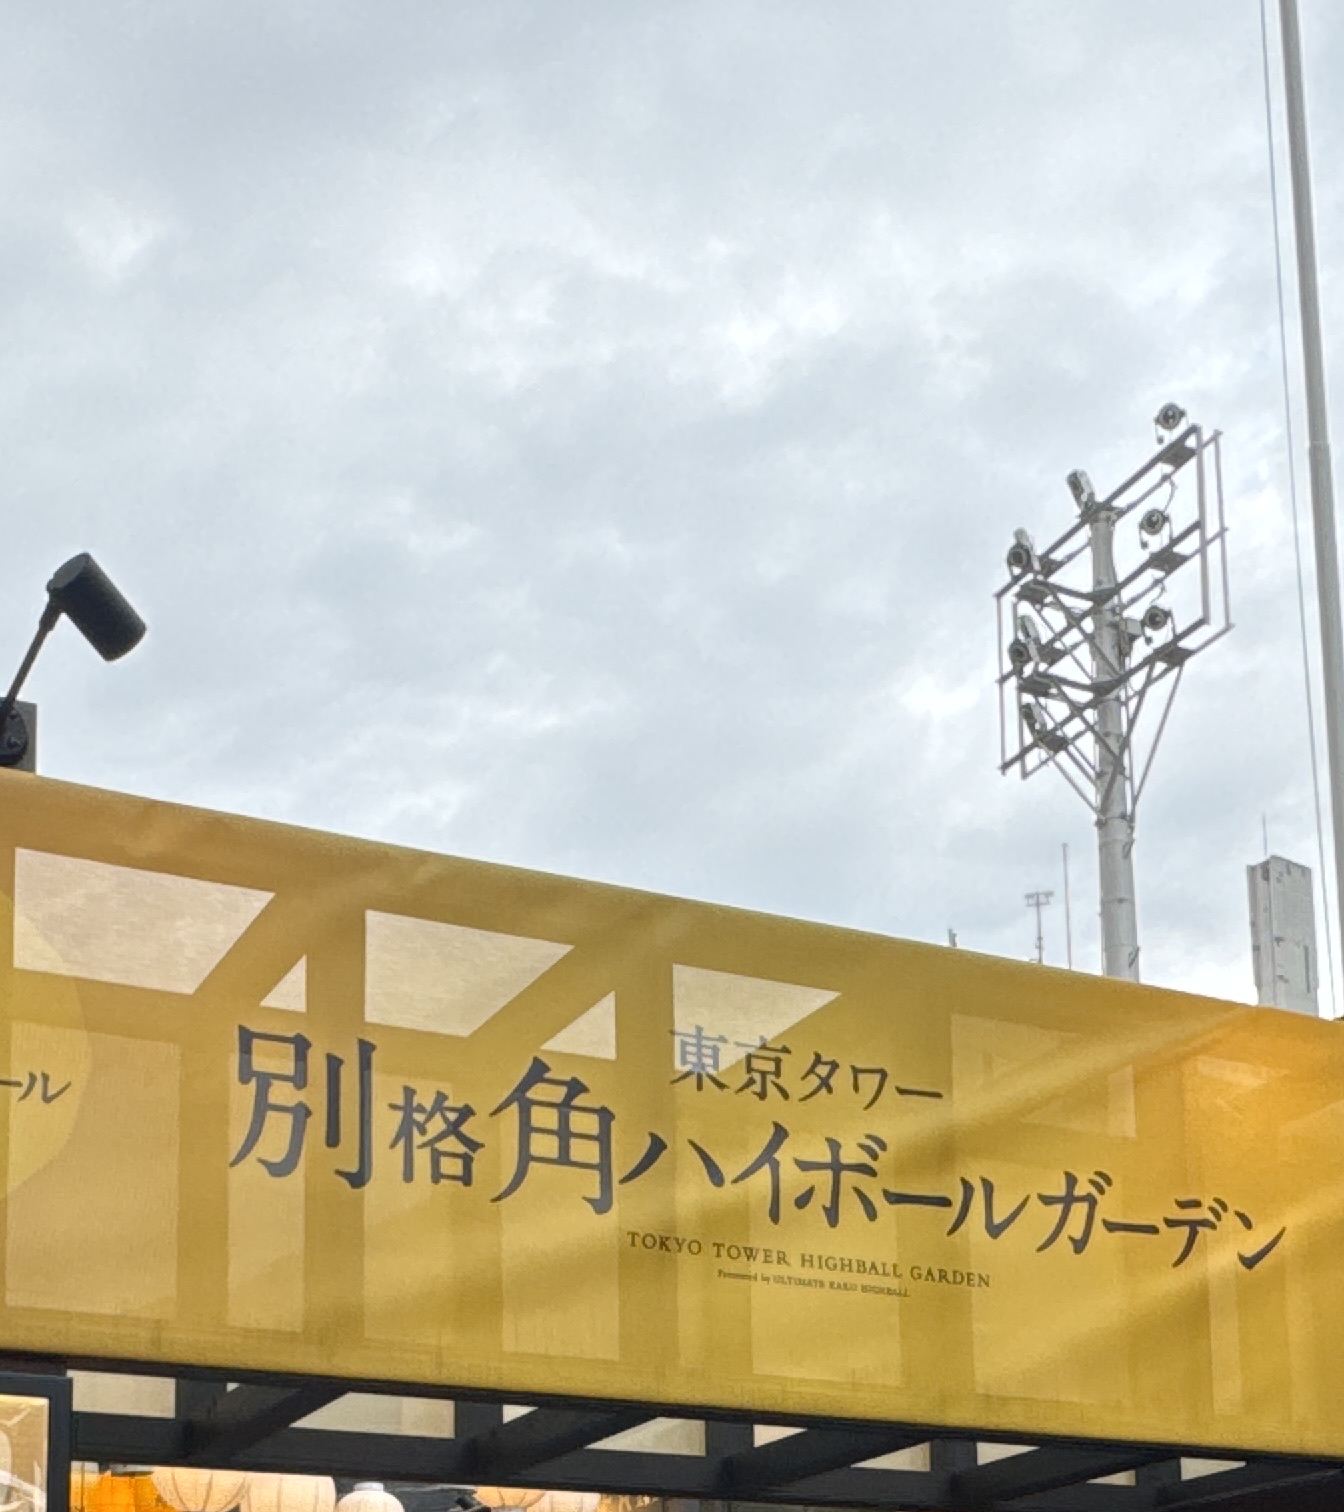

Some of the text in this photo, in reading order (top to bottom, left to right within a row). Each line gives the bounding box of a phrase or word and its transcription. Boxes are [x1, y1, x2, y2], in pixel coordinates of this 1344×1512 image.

[667, 1024, 945, 1113] 東京タワー
[229, 1024, 1287, 1272] 別格角ハイボールガーデン
[626, 1230, 991, 1289] TOKYO TOWER HIGHBALL GARDEN
